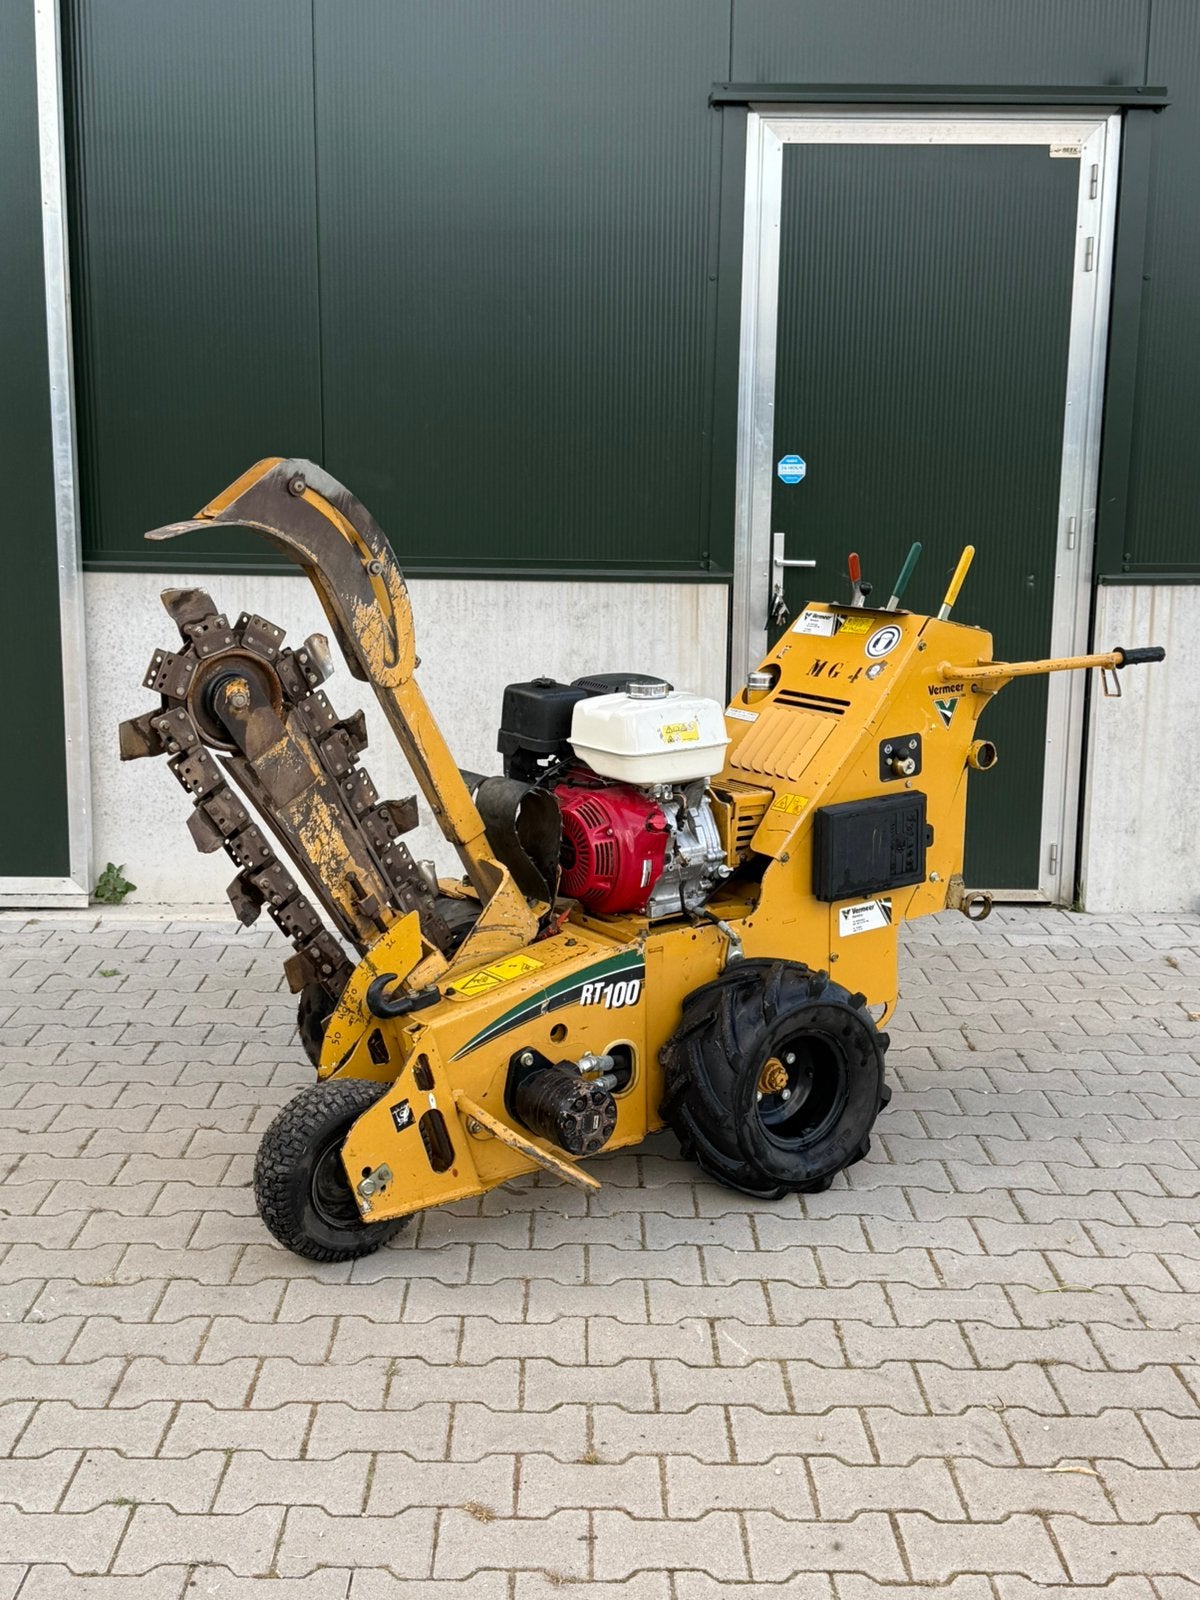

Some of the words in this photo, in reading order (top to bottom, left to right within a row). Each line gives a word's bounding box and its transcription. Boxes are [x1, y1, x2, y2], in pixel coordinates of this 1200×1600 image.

[928, 683, 964, 696] Vermeer
[852, 904, 875, 914] Vermeer
[579, 979, 642, 1010] RT100
